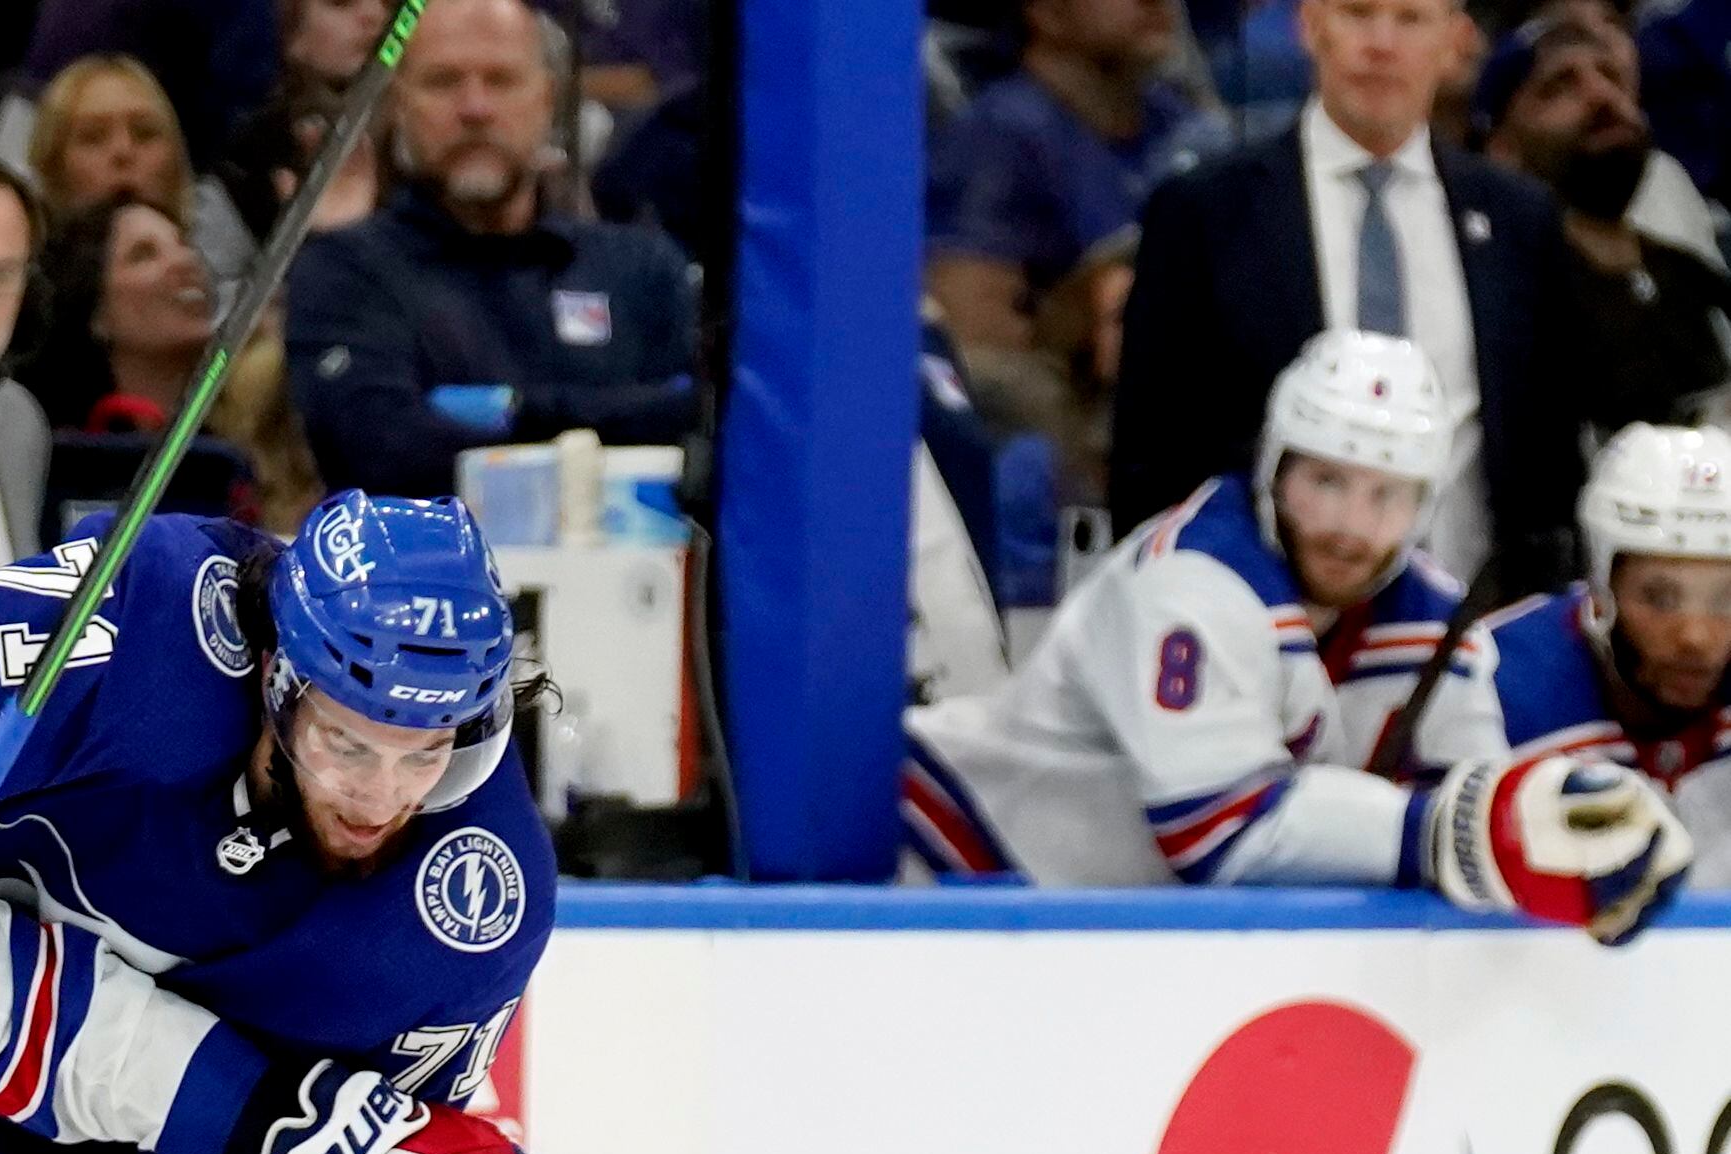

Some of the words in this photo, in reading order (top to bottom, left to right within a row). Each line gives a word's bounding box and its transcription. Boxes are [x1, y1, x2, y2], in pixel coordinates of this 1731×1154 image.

[412, 596, 459, 639] 71
[388, 685, 468, 704] CCM
[1155, 626, 1205, 712] 8
[429, 846, 455, 880] BAY
[457, 836, 520, 901] LIGHTNING
[425, 883, 463, 940] TAMPA
[390, 997, 521, 1102] 71
